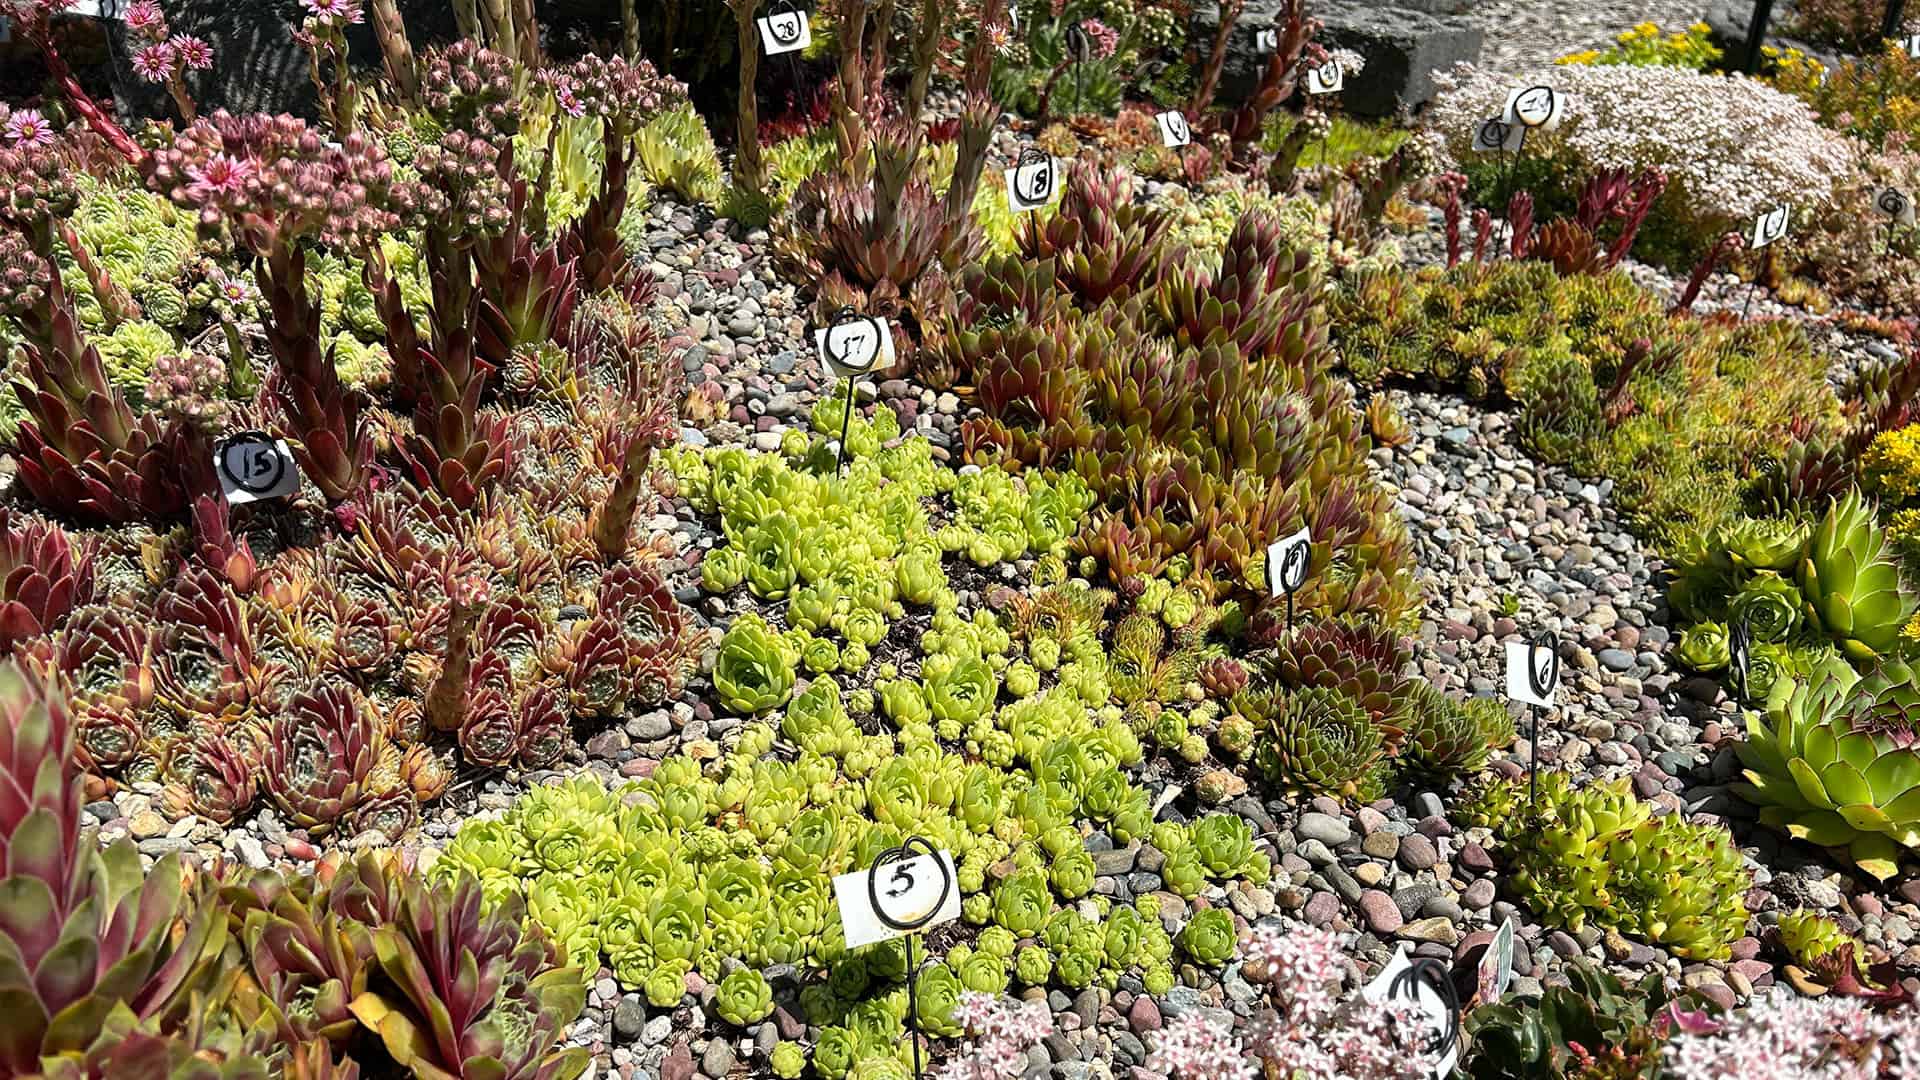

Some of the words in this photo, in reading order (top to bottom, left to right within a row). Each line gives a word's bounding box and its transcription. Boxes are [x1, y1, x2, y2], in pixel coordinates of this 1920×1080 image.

[776, 20, 794, 38] 28
[1029, 168, 1048, 200] 18
[242, 448, 273, 480] 15
[1539, 657, 1551, 685] 6
[886, 862, 917, 898] 5
